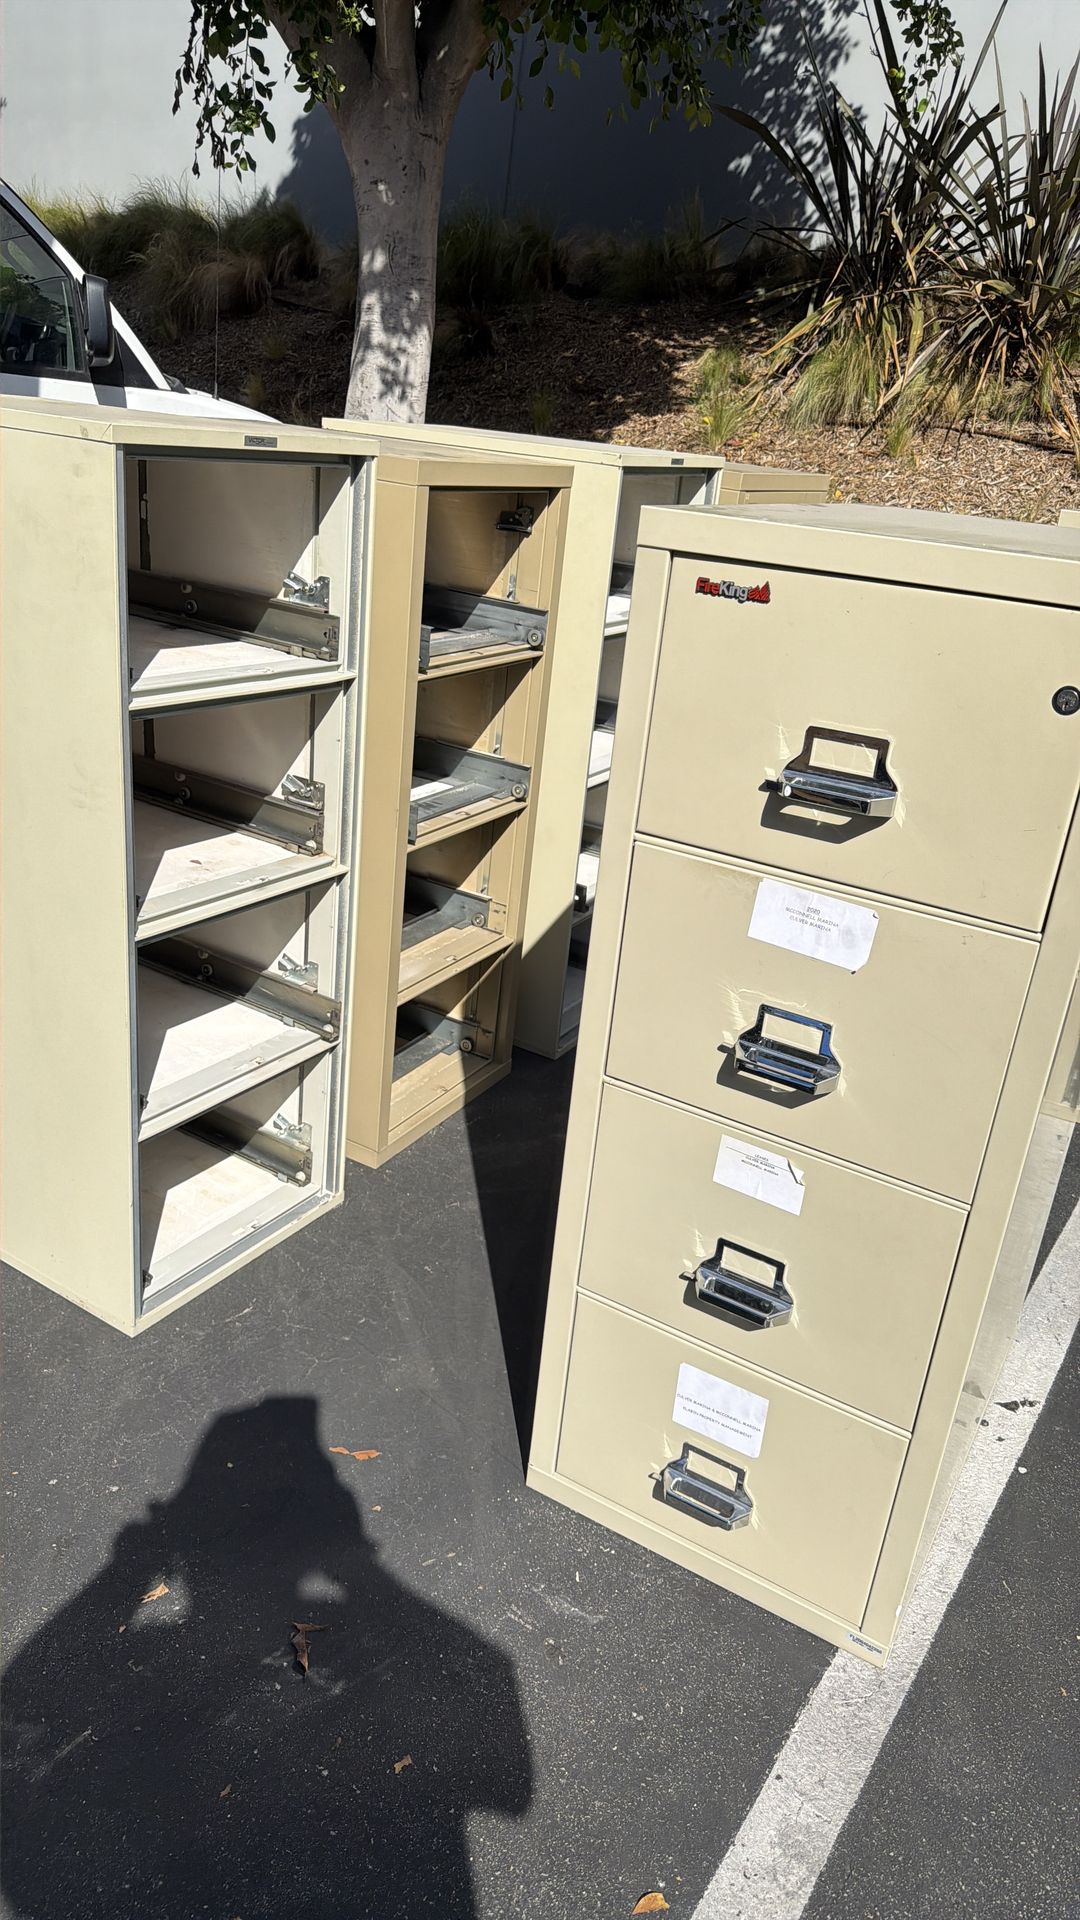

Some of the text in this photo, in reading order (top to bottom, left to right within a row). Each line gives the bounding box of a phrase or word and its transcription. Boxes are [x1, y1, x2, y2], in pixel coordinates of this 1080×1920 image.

[695, 576, 748, 603] FireKing
[789, 915, 831, 932] CULVER MARINA
[817, 917, 839, 928] MARINA
[677, 1393, 693, 1403] CULVER
[693, 1400, 711, 1410] MARINA
[742, 1421, 761, 1432] MARINA
[699, 1413, 720, 1425] PROPERTY
[721, 1423, 752, 1439] MANAGEMENT
